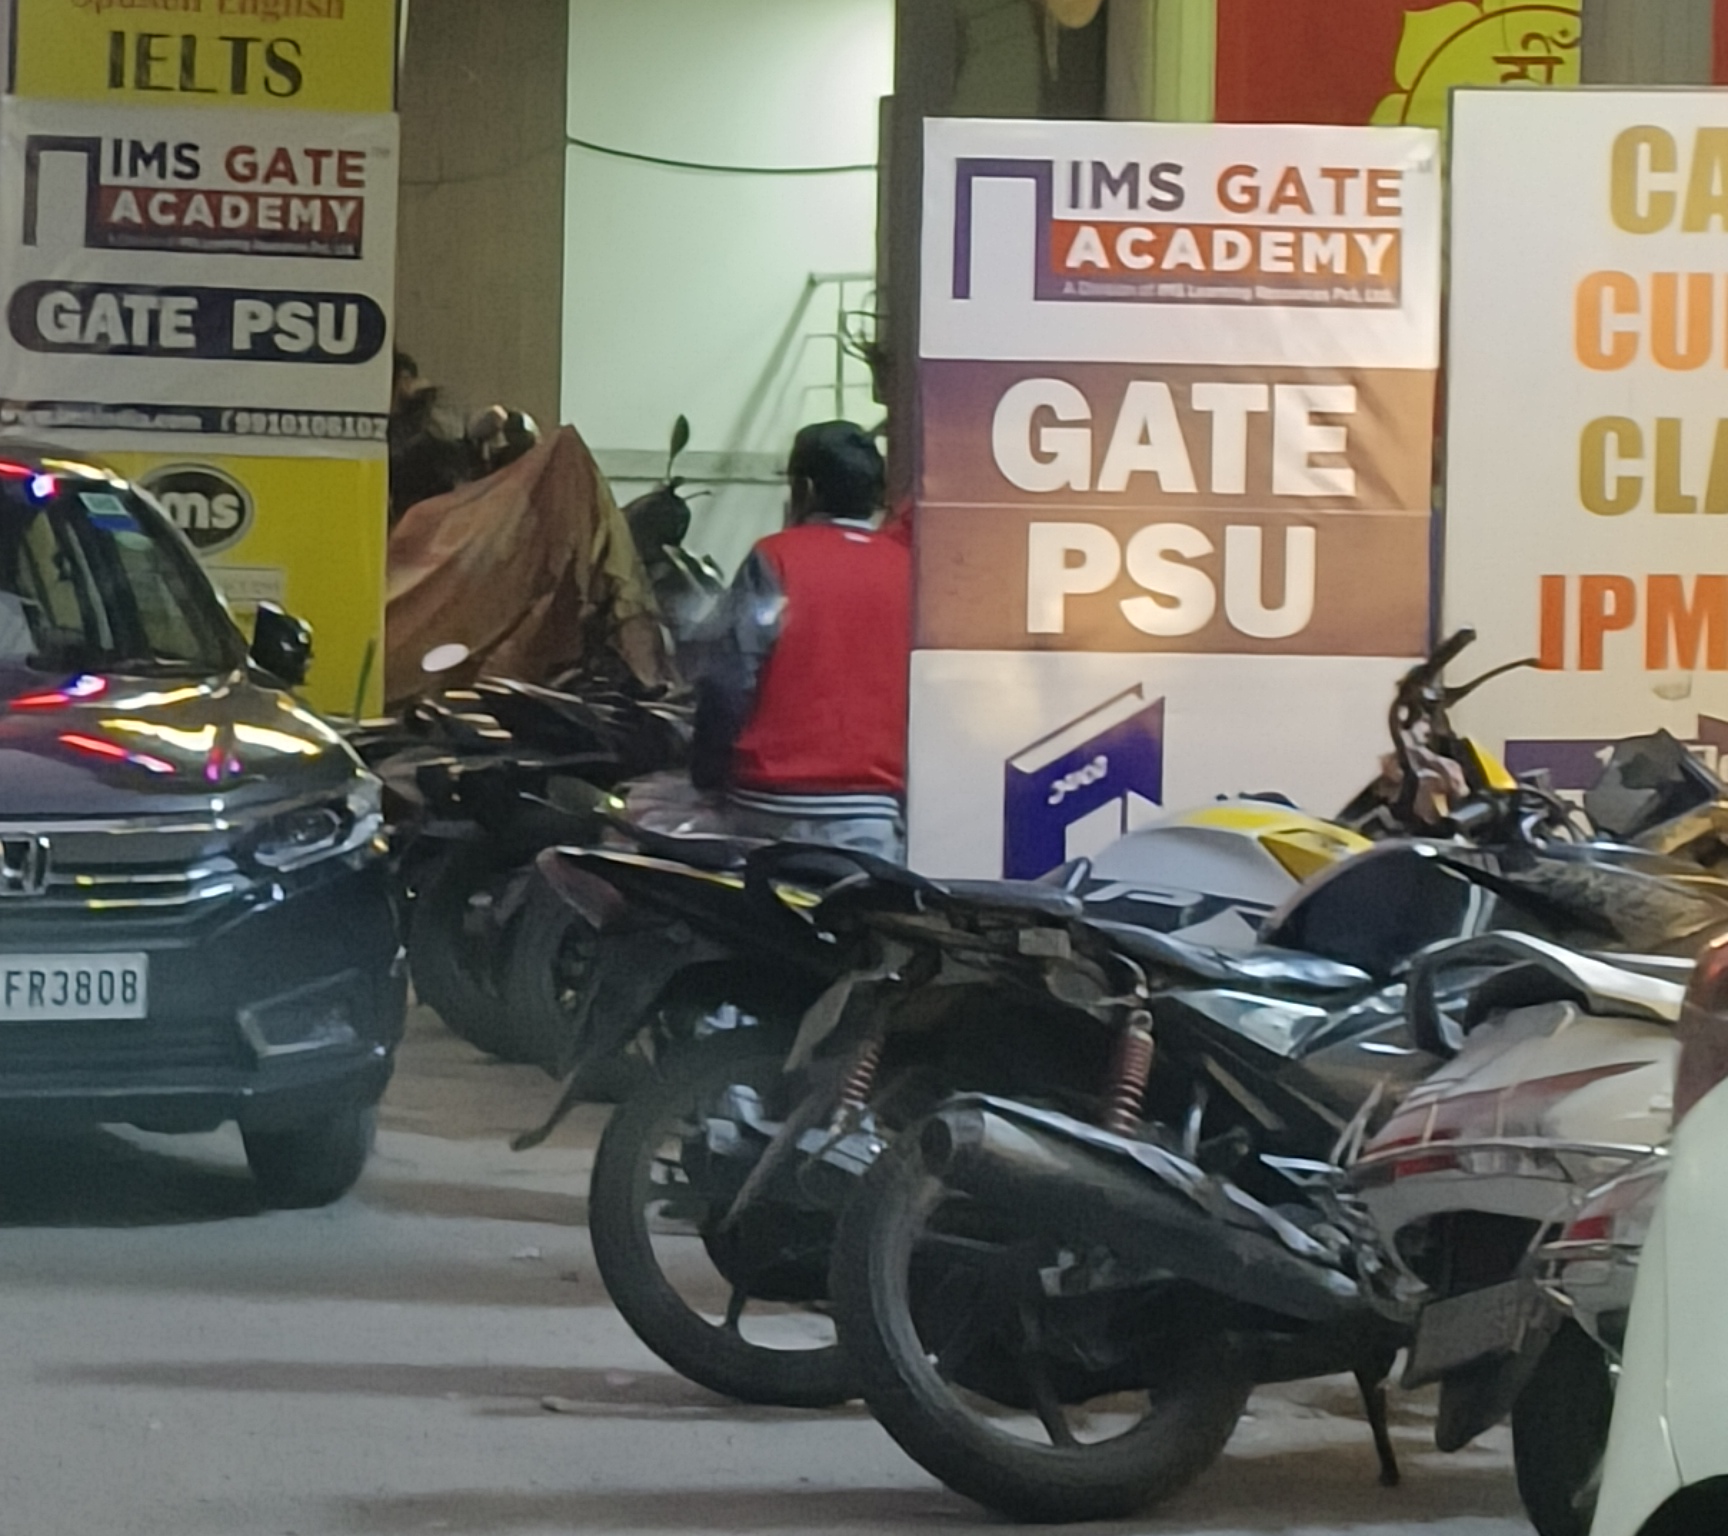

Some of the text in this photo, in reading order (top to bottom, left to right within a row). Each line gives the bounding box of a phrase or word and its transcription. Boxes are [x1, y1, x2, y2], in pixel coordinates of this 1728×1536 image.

[108, 29, 304, 98] IELTS
[111, 137, 367, 189] IMS GATE
[1067, 160, 1404, 217] IMS GATE
[107, 189, 359, 233] ACADEMY
[1064, 225, 1395, 276] ACADEMY
[34, 291, 359, 355] GATE PSU
[1574, 270, 1728, 373] CU
[990, 377, 1357, 498] GATE
[158, 490, 241, 530] ms
[1026, 521, 1317, 640] PSU
[1538, 573, 1728, 674] IPM
